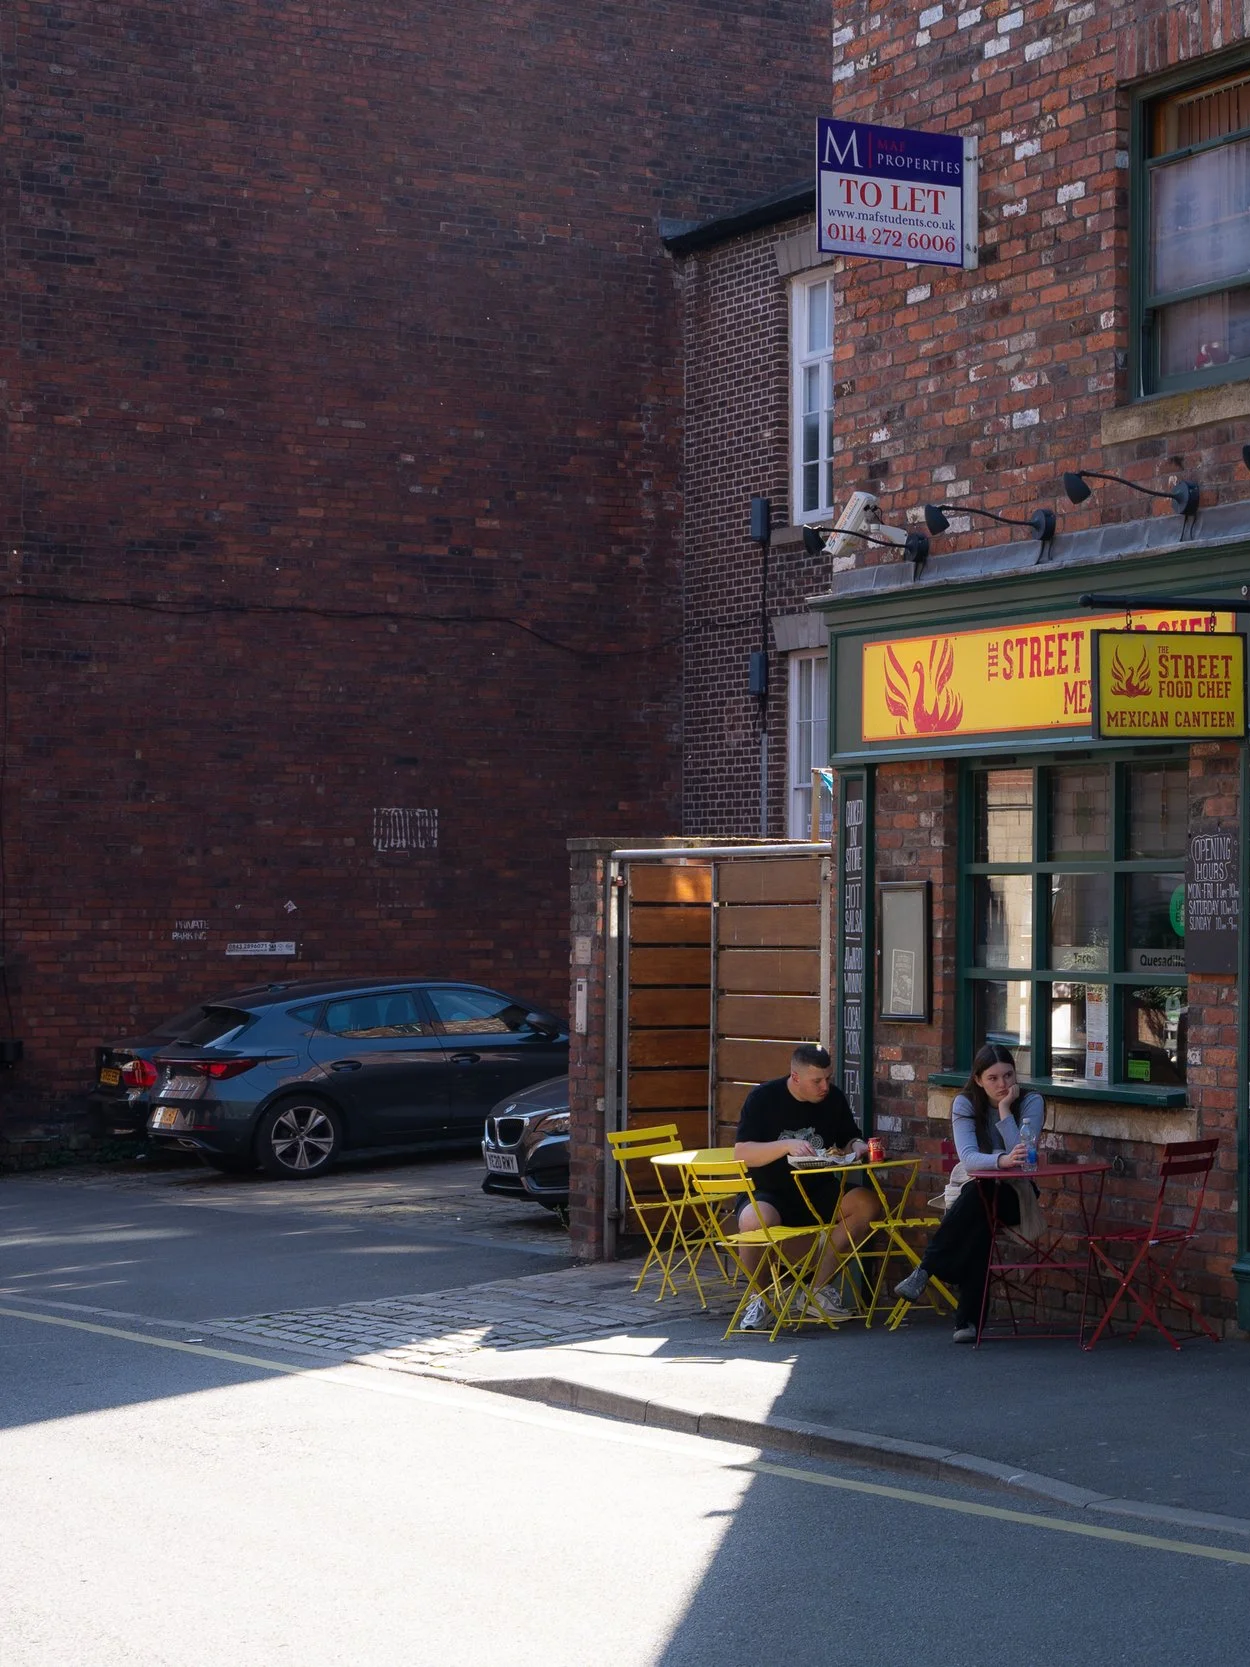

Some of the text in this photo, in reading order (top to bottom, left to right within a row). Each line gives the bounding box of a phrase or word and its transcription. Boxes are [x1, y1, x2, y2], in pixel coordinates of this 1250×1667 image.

[822, 126, 864, 168] M
[877, 139, 905, 152] MAF
[877, 152, 961, 175] PROPERTIES
[839, 178, 946, 216] TO LET
[827, 208, 956, 231] www.mafstudents.co.uk
[827, 223, 956, 253] 0114 272 6006
[987, 630, 1085, 681] THE STREET
[1157, 645, 1170, 654] THE
[1157, 654, 1233, 680] STREET
[1158, 680, 1232, 699] FOOD CHEF
[1106, 710, 1236, 728] MEXICAN CANTEEN
[1194, 837, 1231, 861] OPENING
[1196, 862, 1224, 880] HOURS
[845, 883, 861, 909] HOT
[1188, 899, 1219, 915] SATURDAY
[845, 909, 863, 933] SALSA
[1189, 916, 1211, 931] SUNDAY
[1073, 952, 1096, 964] Tacos
[844, 1006, 862, 1030] LOCAL
[845, 1030, 861, 1055] PORK
[844, 1069, 861, 1095] TEA
